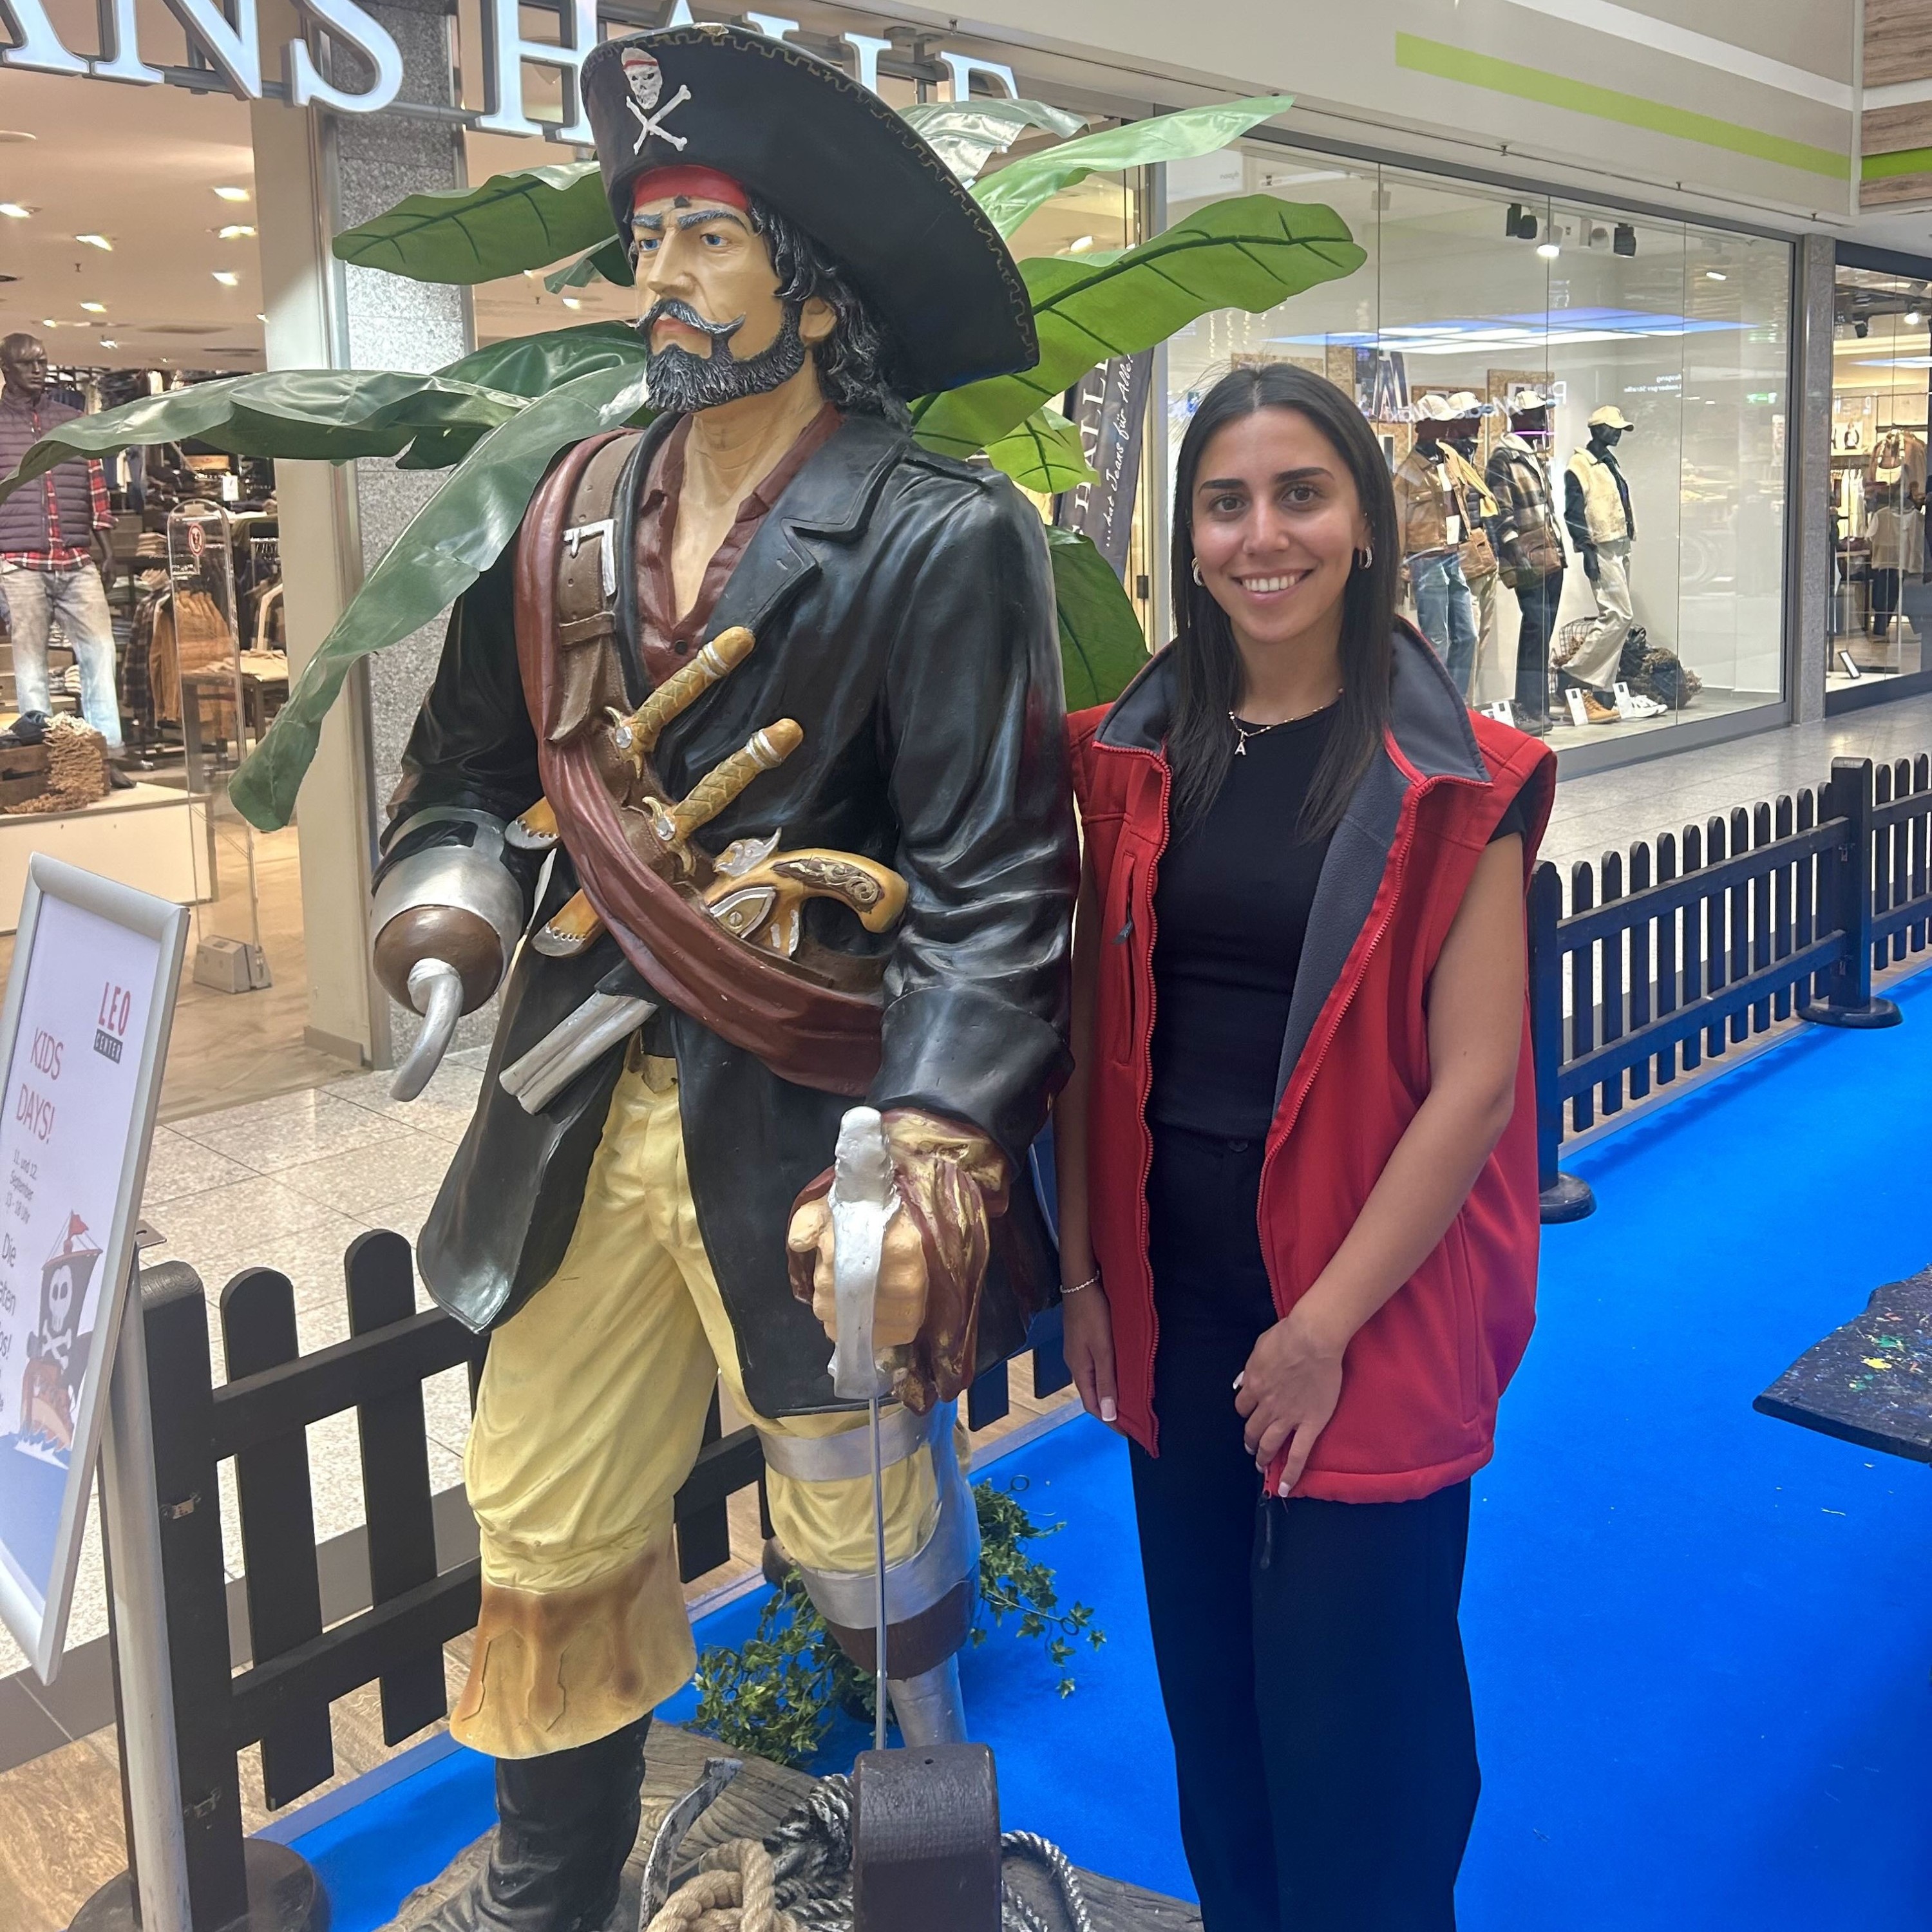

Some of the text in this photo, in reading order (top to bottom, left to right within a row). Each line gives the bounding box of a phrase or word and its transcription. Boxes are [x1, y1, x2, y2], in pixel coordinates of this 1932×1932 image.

[1112, 407, 1130, 440] für
[1106, 442, 1124, 491] Jeans
[99, 981, 131, 1036] LEO
[30, 1027, 64, 1081] KIDS
[95, 1032, 122, 1061] CENTER
[16, 1083, 55, 1144] DAYS!
[2, 1232, 17, 1268] Die
